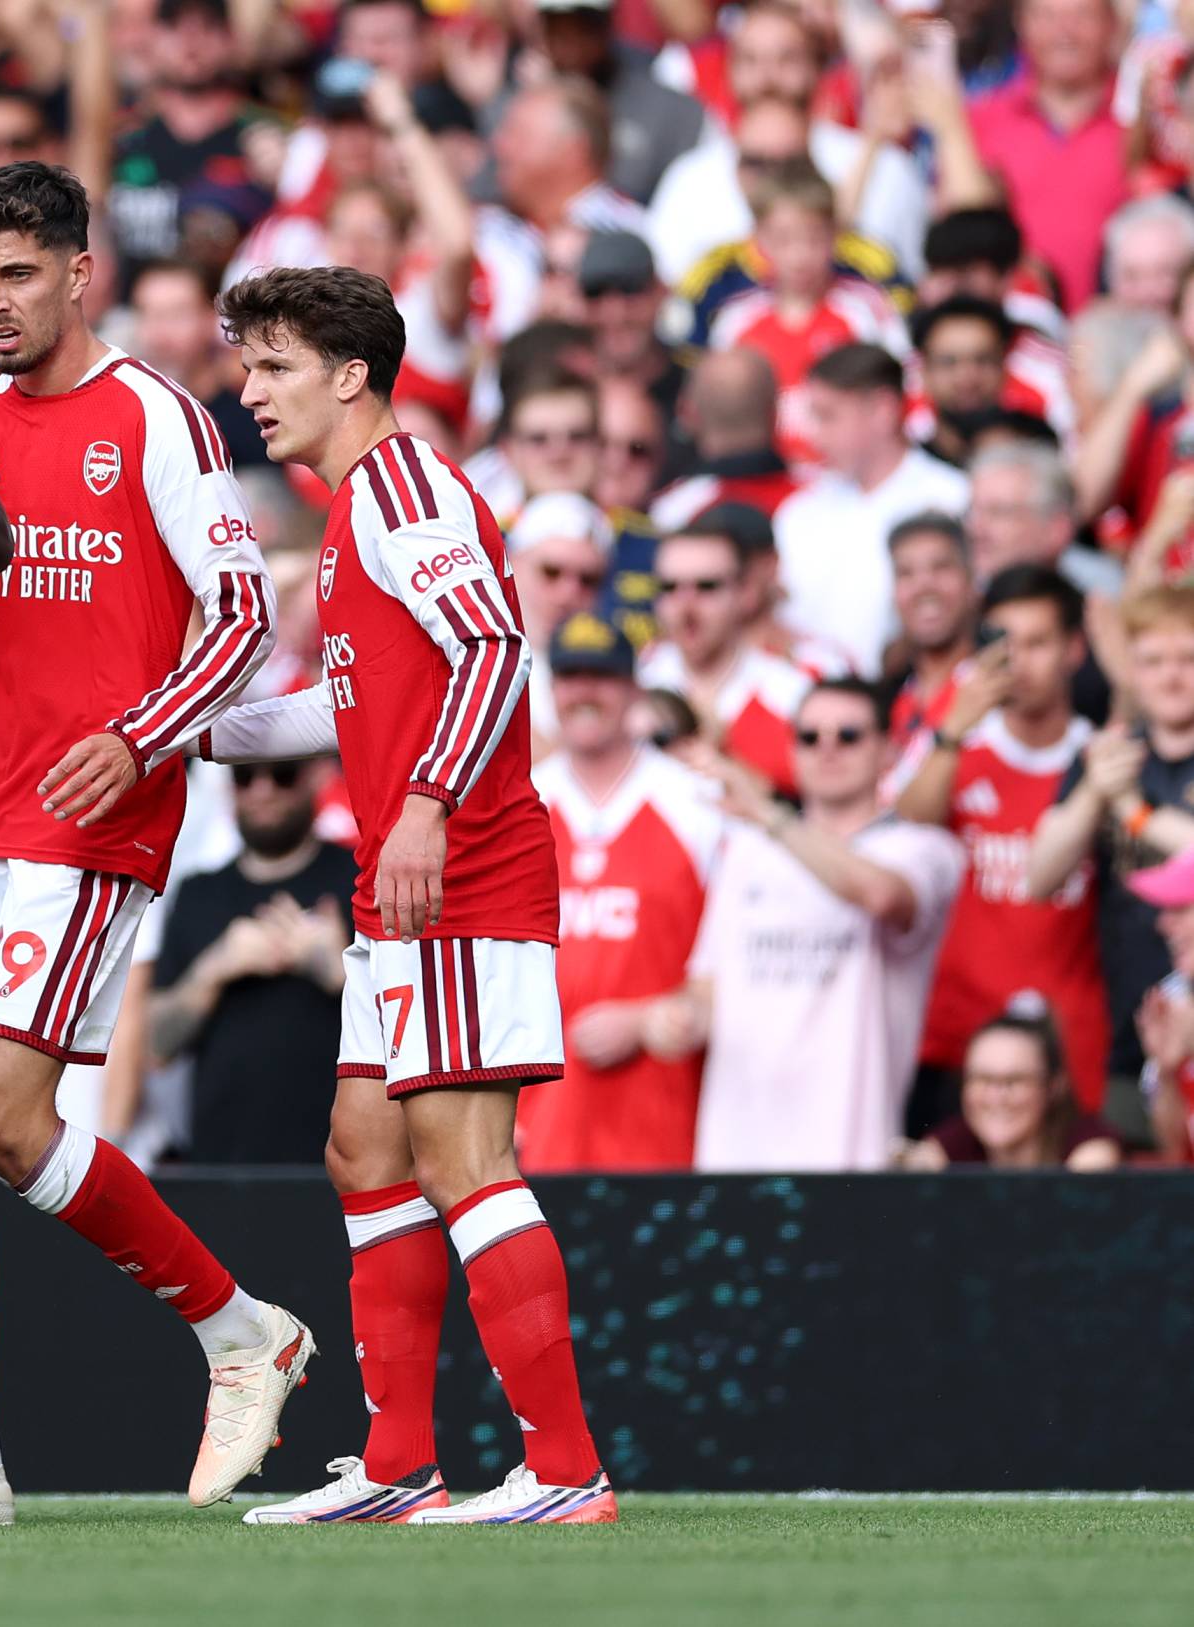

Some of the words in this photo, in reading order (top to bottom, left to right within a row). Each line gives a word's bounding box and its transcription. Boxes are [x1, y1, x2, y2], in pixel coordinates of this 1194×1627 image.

[10, 514, 123, 564] irates
[20, 565, 93, 603] BETTER
[411, 542, 483, 593] deel.
[375, 984, 414, 1060] 7
